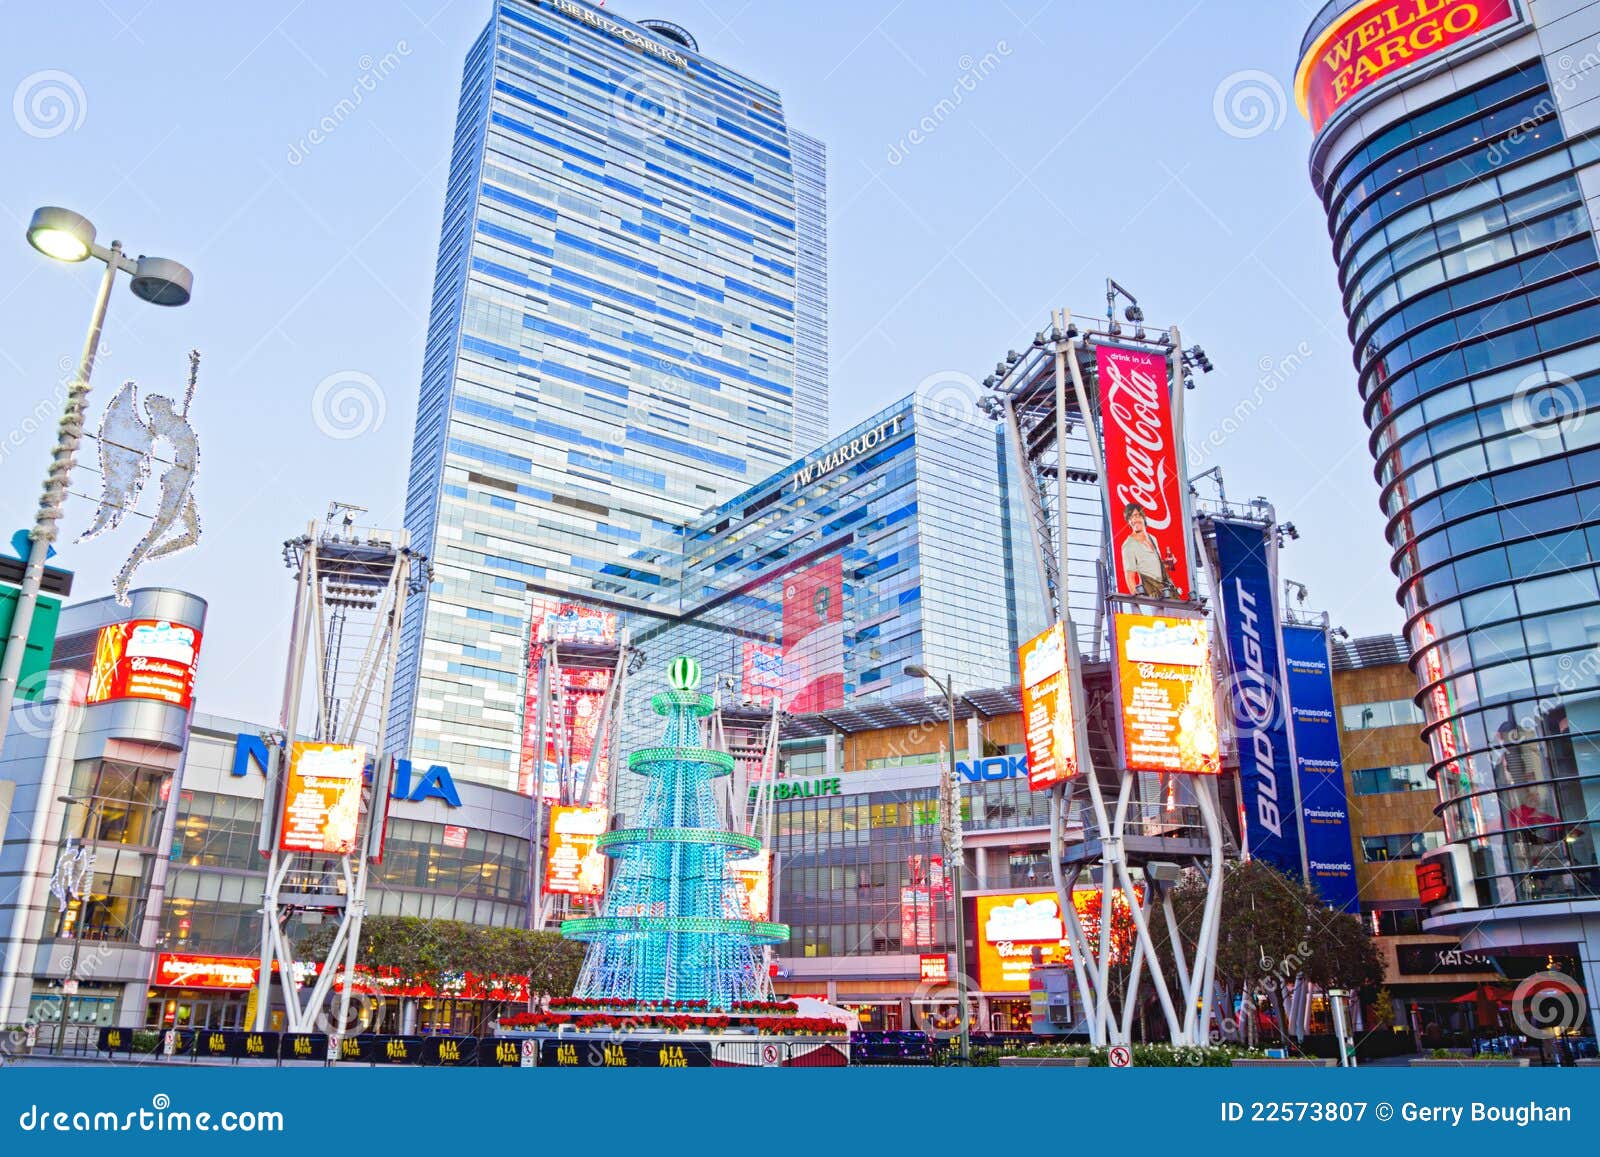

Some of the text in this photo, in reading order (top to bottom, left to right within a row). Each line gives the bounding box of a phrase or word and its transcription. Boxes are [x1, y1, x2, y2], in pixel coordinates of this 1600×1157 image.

[1323, 0, 1455, 72] WELL
[1331, 4, 1478, 104] FARGO
[1111, 353, 1130, 362] drink
[793, 415, 906, 493] JW MARRIOTT
[1287, 658, 1326, 669] Panasonic
[1236, 577, 1282, 838] BUD LIGHT
[1292, 707, 1332, 718] Panasonic
[1298, 757, 1339, 768] Panasonic
[1304, 808, 1345, 818] Panasonic
[1310, 861, 1352, 871] Panasonic
[504, 1043, 516, 1053] LA
[565, 1044, 576, 1056] LA
[612, 1045, 624, 1057] LA
[669, 1046, 683, 1059] LA
[611, 1057, 628, 1067] LIVE
[668, 1058, 688, 1067] LIVE
